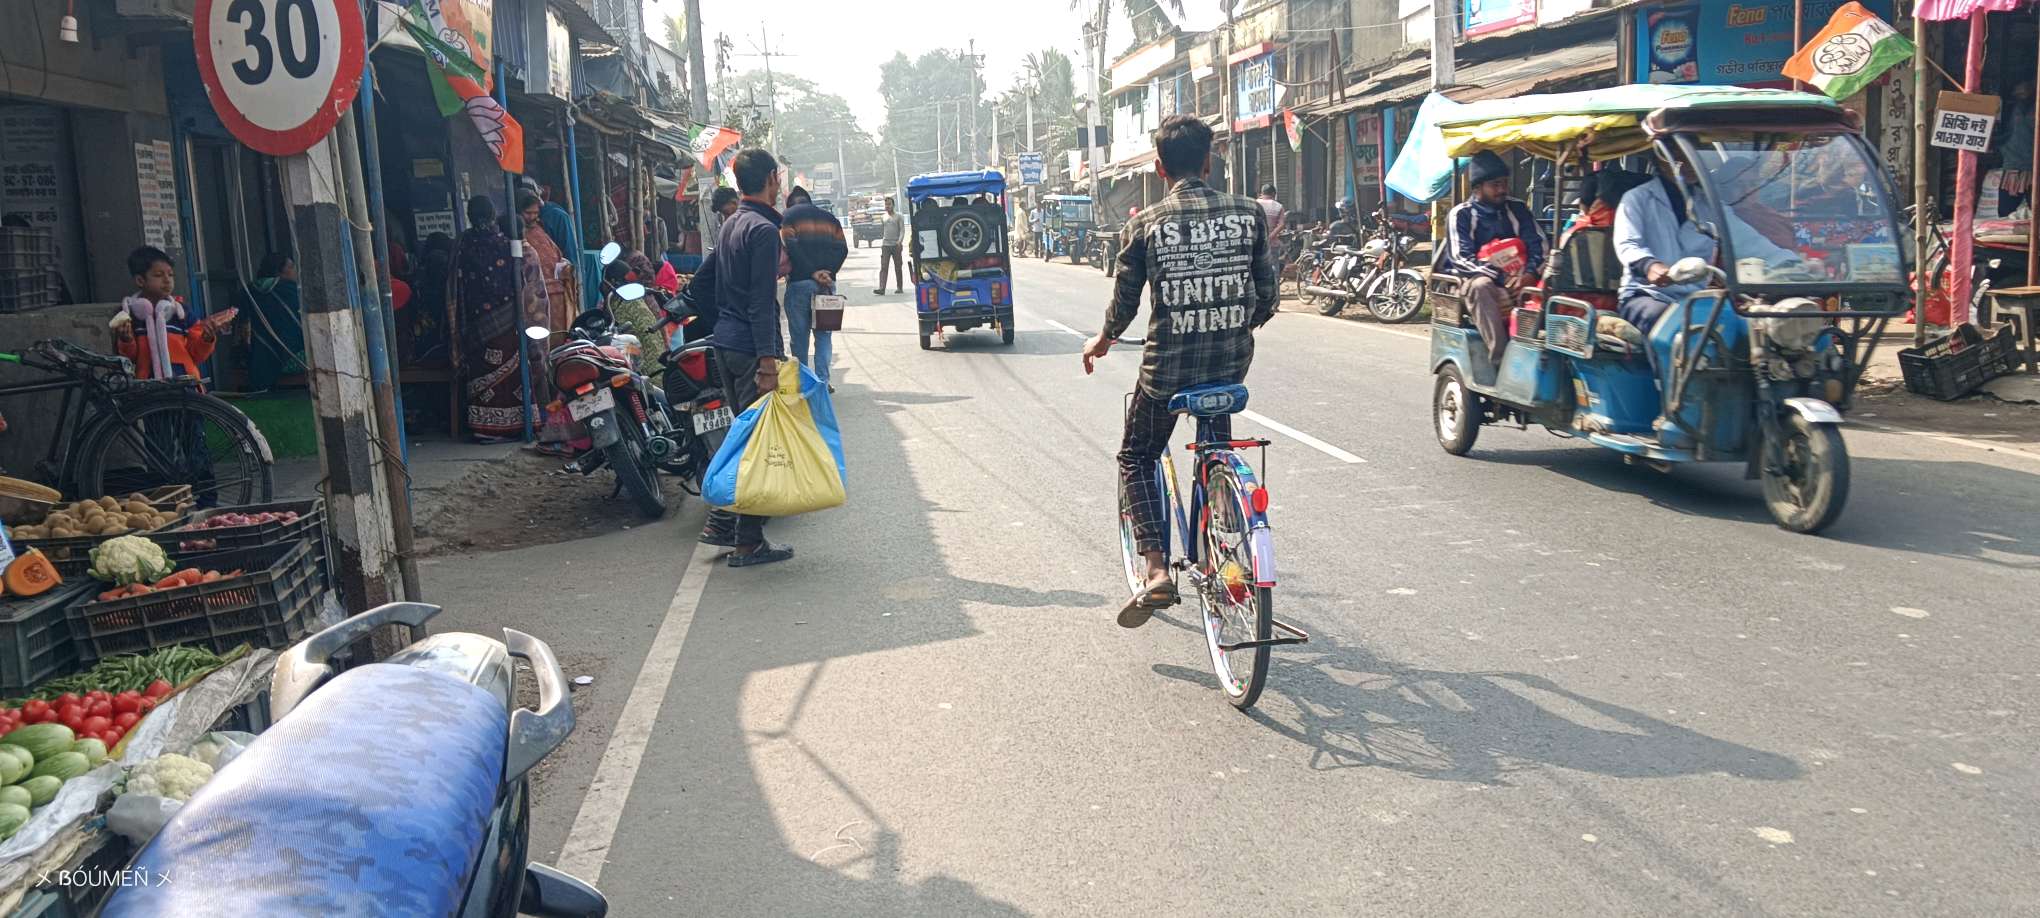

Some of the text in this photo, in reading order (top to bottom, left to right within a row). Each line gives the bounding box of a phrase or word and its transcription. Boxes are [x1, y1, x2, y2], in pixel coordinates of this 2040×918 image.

[1728, 4, 1766, 26] Fena
[227, 0, 320, 86] 30
[1940, 112, 1988, 134] মিষ্টি দই
[1935, 130, 1987, 150] পাওয়া যায়
[1154, 214, 1256, 247] IS BEST
[1160, 272, 1249, 306] UNITY
[1170, 304, 1245, 334] MIND
